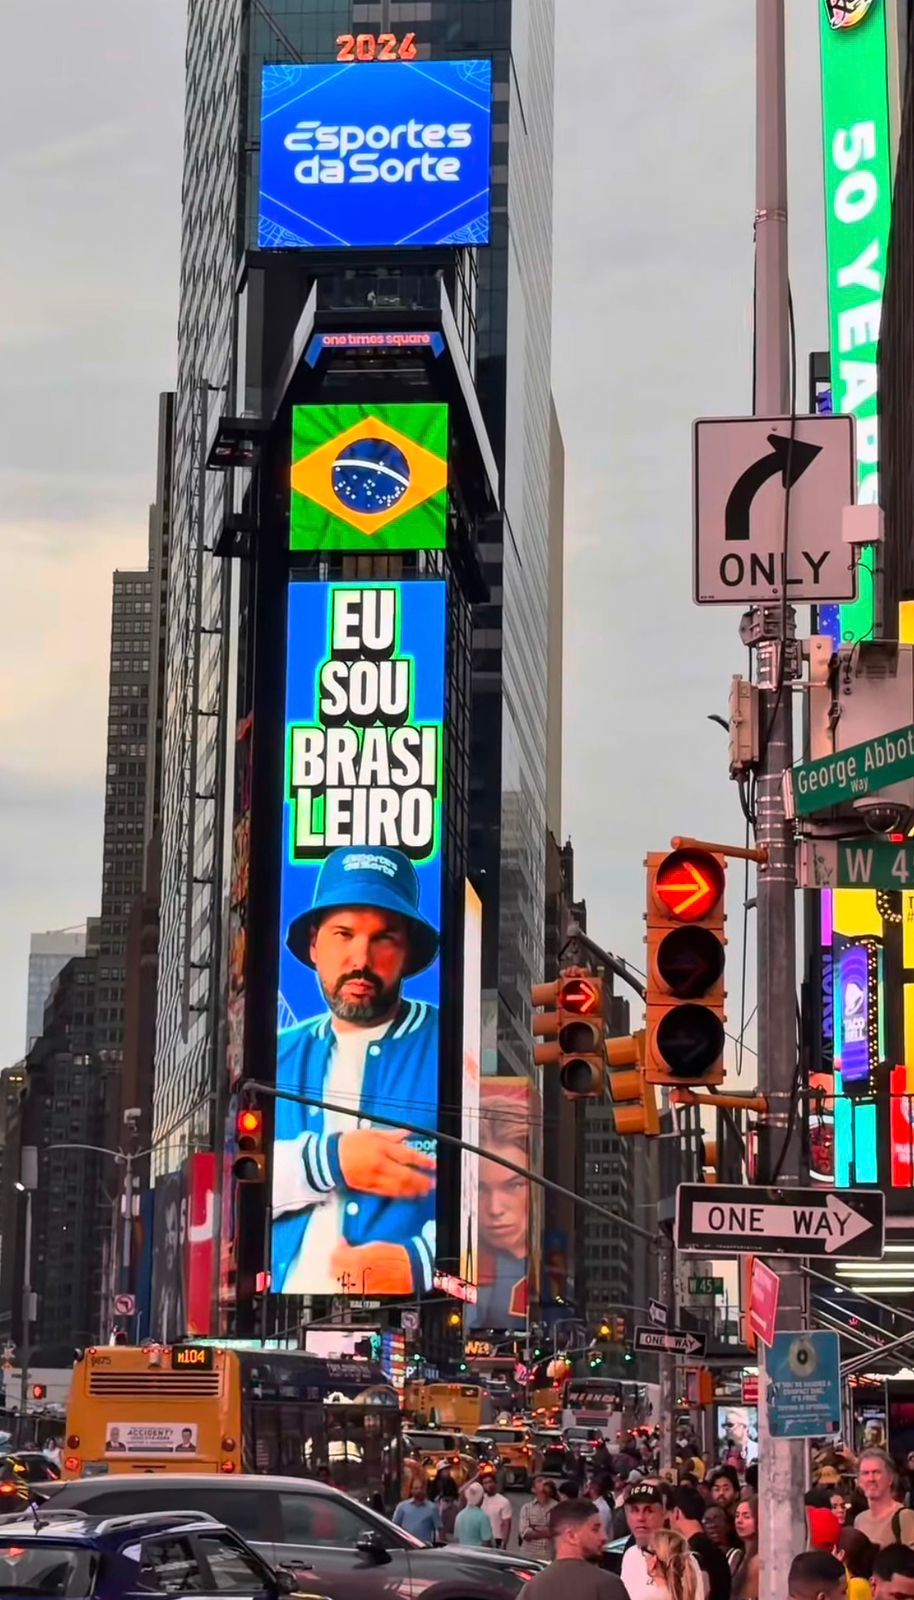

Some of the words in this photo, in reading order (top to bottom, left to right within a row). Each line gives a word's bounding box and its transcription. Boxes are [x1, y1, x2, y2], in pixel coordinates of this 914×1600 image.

[336, 33, 417, 61] 2026
[284, 119, 473, 157] Esportes
[833, 120, 879, 225] 50
[322, 336, 346, 345] one
[348, 334, 384, 344] times
[386, 334, 431, 347] square
[719, 551, 830, 586] ONLY
[332, 589, 396, 651] EU
[320, 660, 409, 716] SOU
[291, 727, 437, 787] BRASI
[798, 757, 857, 794] George
[850, 777, 869, 792] Way
[295, 787, 433, 847] LEIRO
[846, 848, 873, 882] W
[890, 849, 914, 883] 4
[708, 1206, 765, 1233] ONE
[792, 1210, 853, 1237] WAY
[700, 1279, 713, 1293] 45
[178, 1349, 205, 1364] M104
[645, 1335, 665, 1345] ONE
[675, 1338, 696, 1349] WAY
[630, 1485, 654, 1495] ICON
